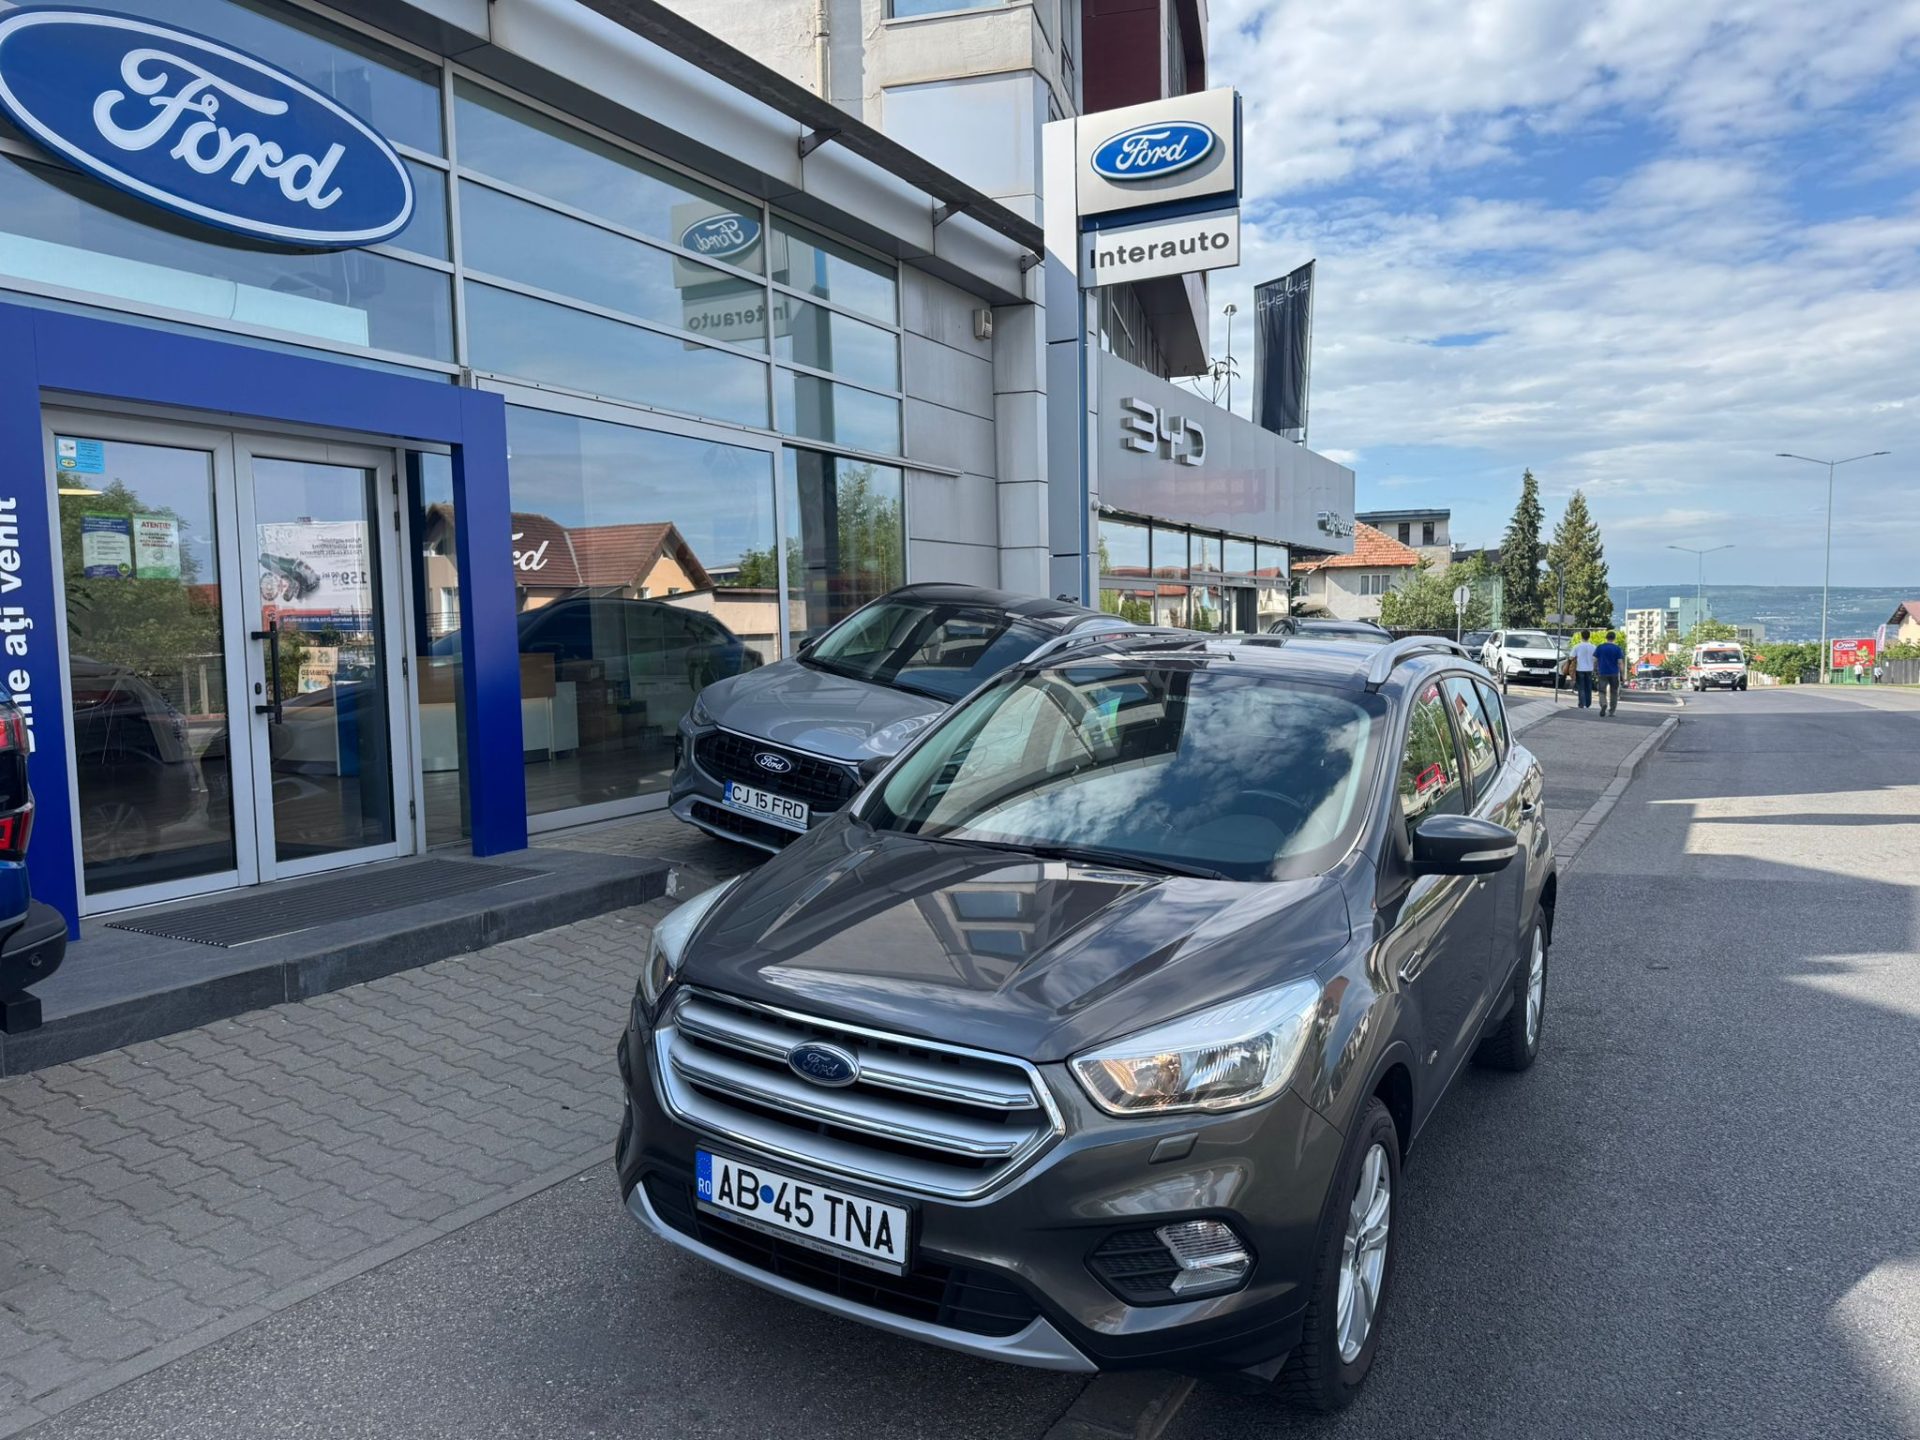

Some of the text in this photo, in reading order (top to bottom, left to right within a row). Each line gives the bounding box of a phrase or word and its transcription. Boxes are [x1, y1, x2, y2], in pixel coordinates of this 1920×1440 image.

[93, 48, 346, 210] Ford
[1115, 130, 1189, 171] Ford
[1090, 231, 1230, 269] Interauto
[1121, 397, 1206, 467] BYD
[760, 755, 784, 771] Ford
[732, 785, 750, 804] CJ
[755, 792, 768, 809] 15
[771, 797, 804, 819] FRD
[802, 1052, 838, 1077] Ford
[698, 1177, 712, 1195] RO
[718, 1164, 895, 1254] AB 45 TNA
